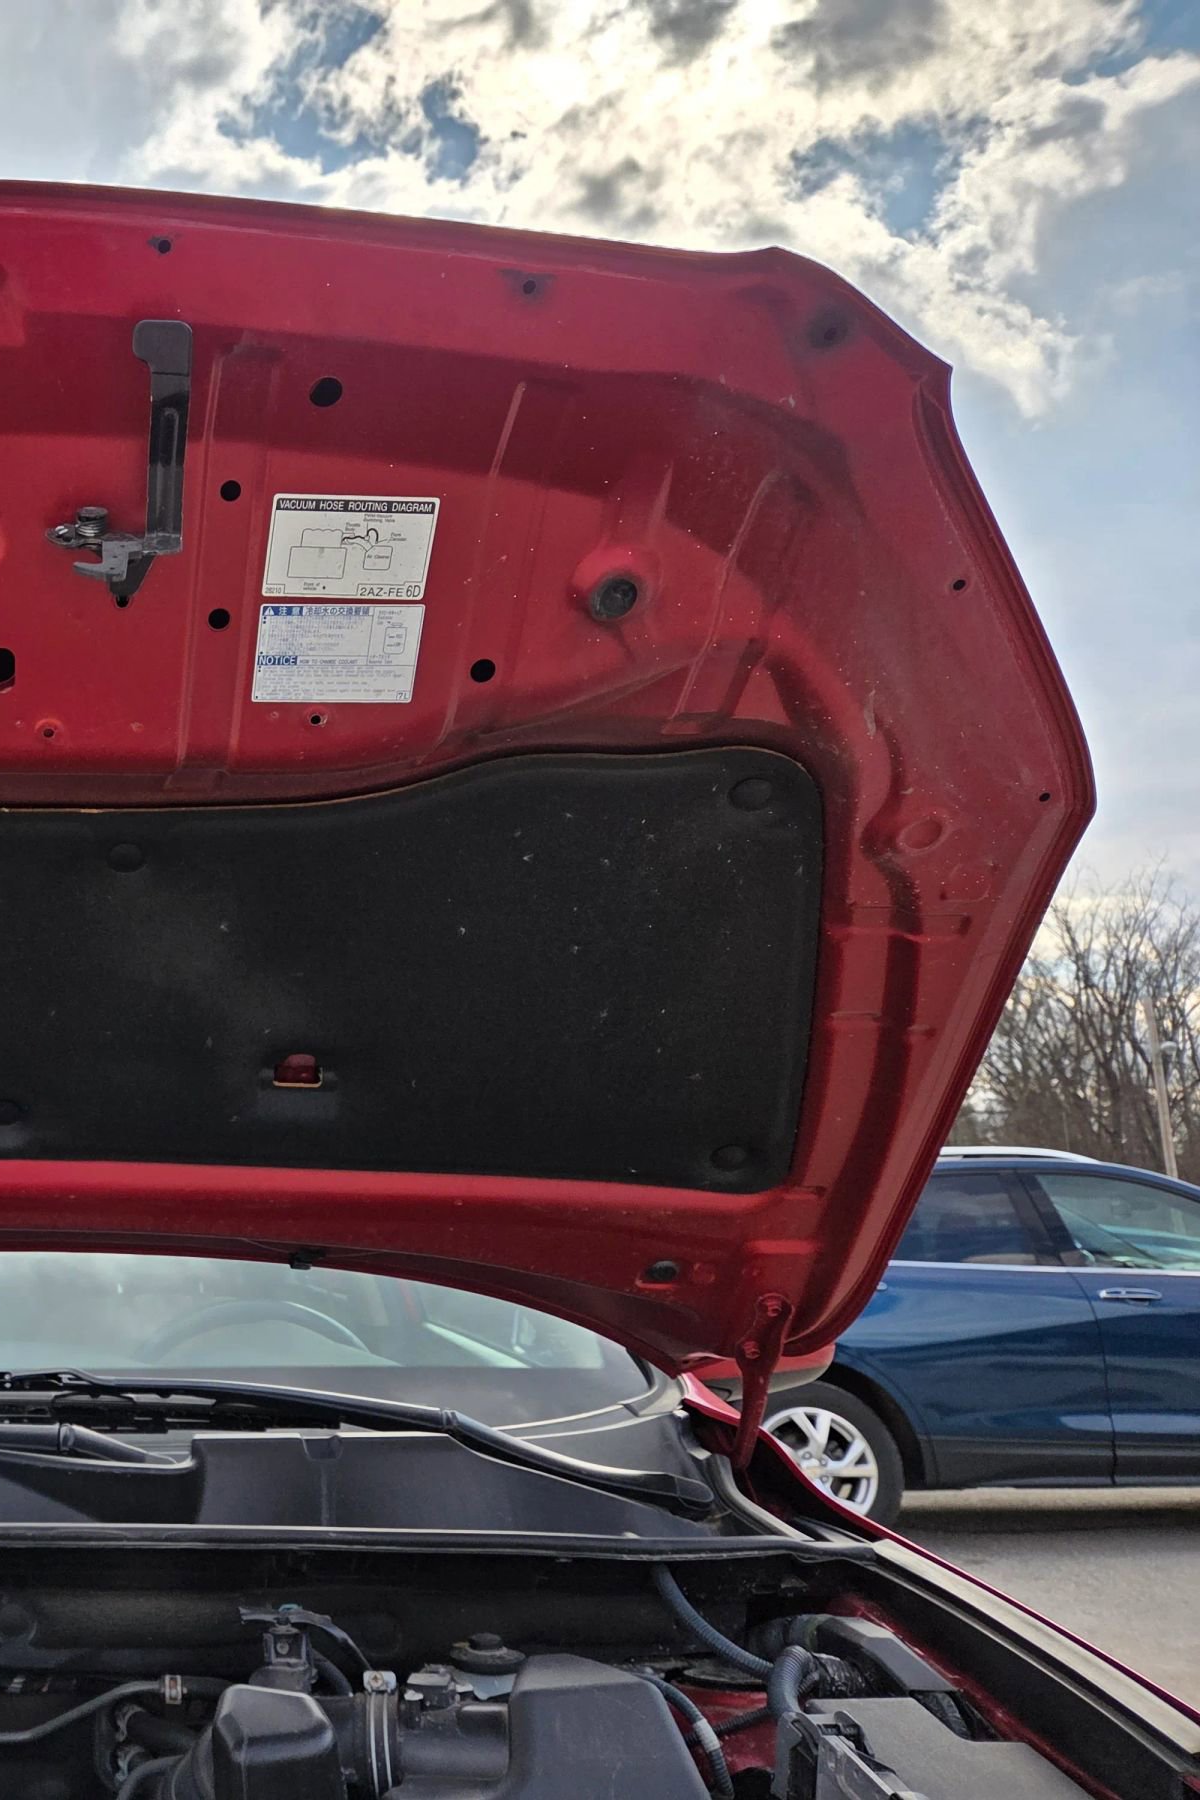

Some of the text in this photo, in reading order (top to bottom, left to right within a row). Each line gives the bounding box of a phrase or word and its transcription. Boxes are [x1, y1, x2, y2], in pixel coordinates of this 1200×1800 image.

[279, 500, 432, 512] VACUUM HOSE ROUTING DIAGRAM
[360, 585, 421, 598] 2AZ-FE 6D
[259, 656, 296, 665] NOTICE
